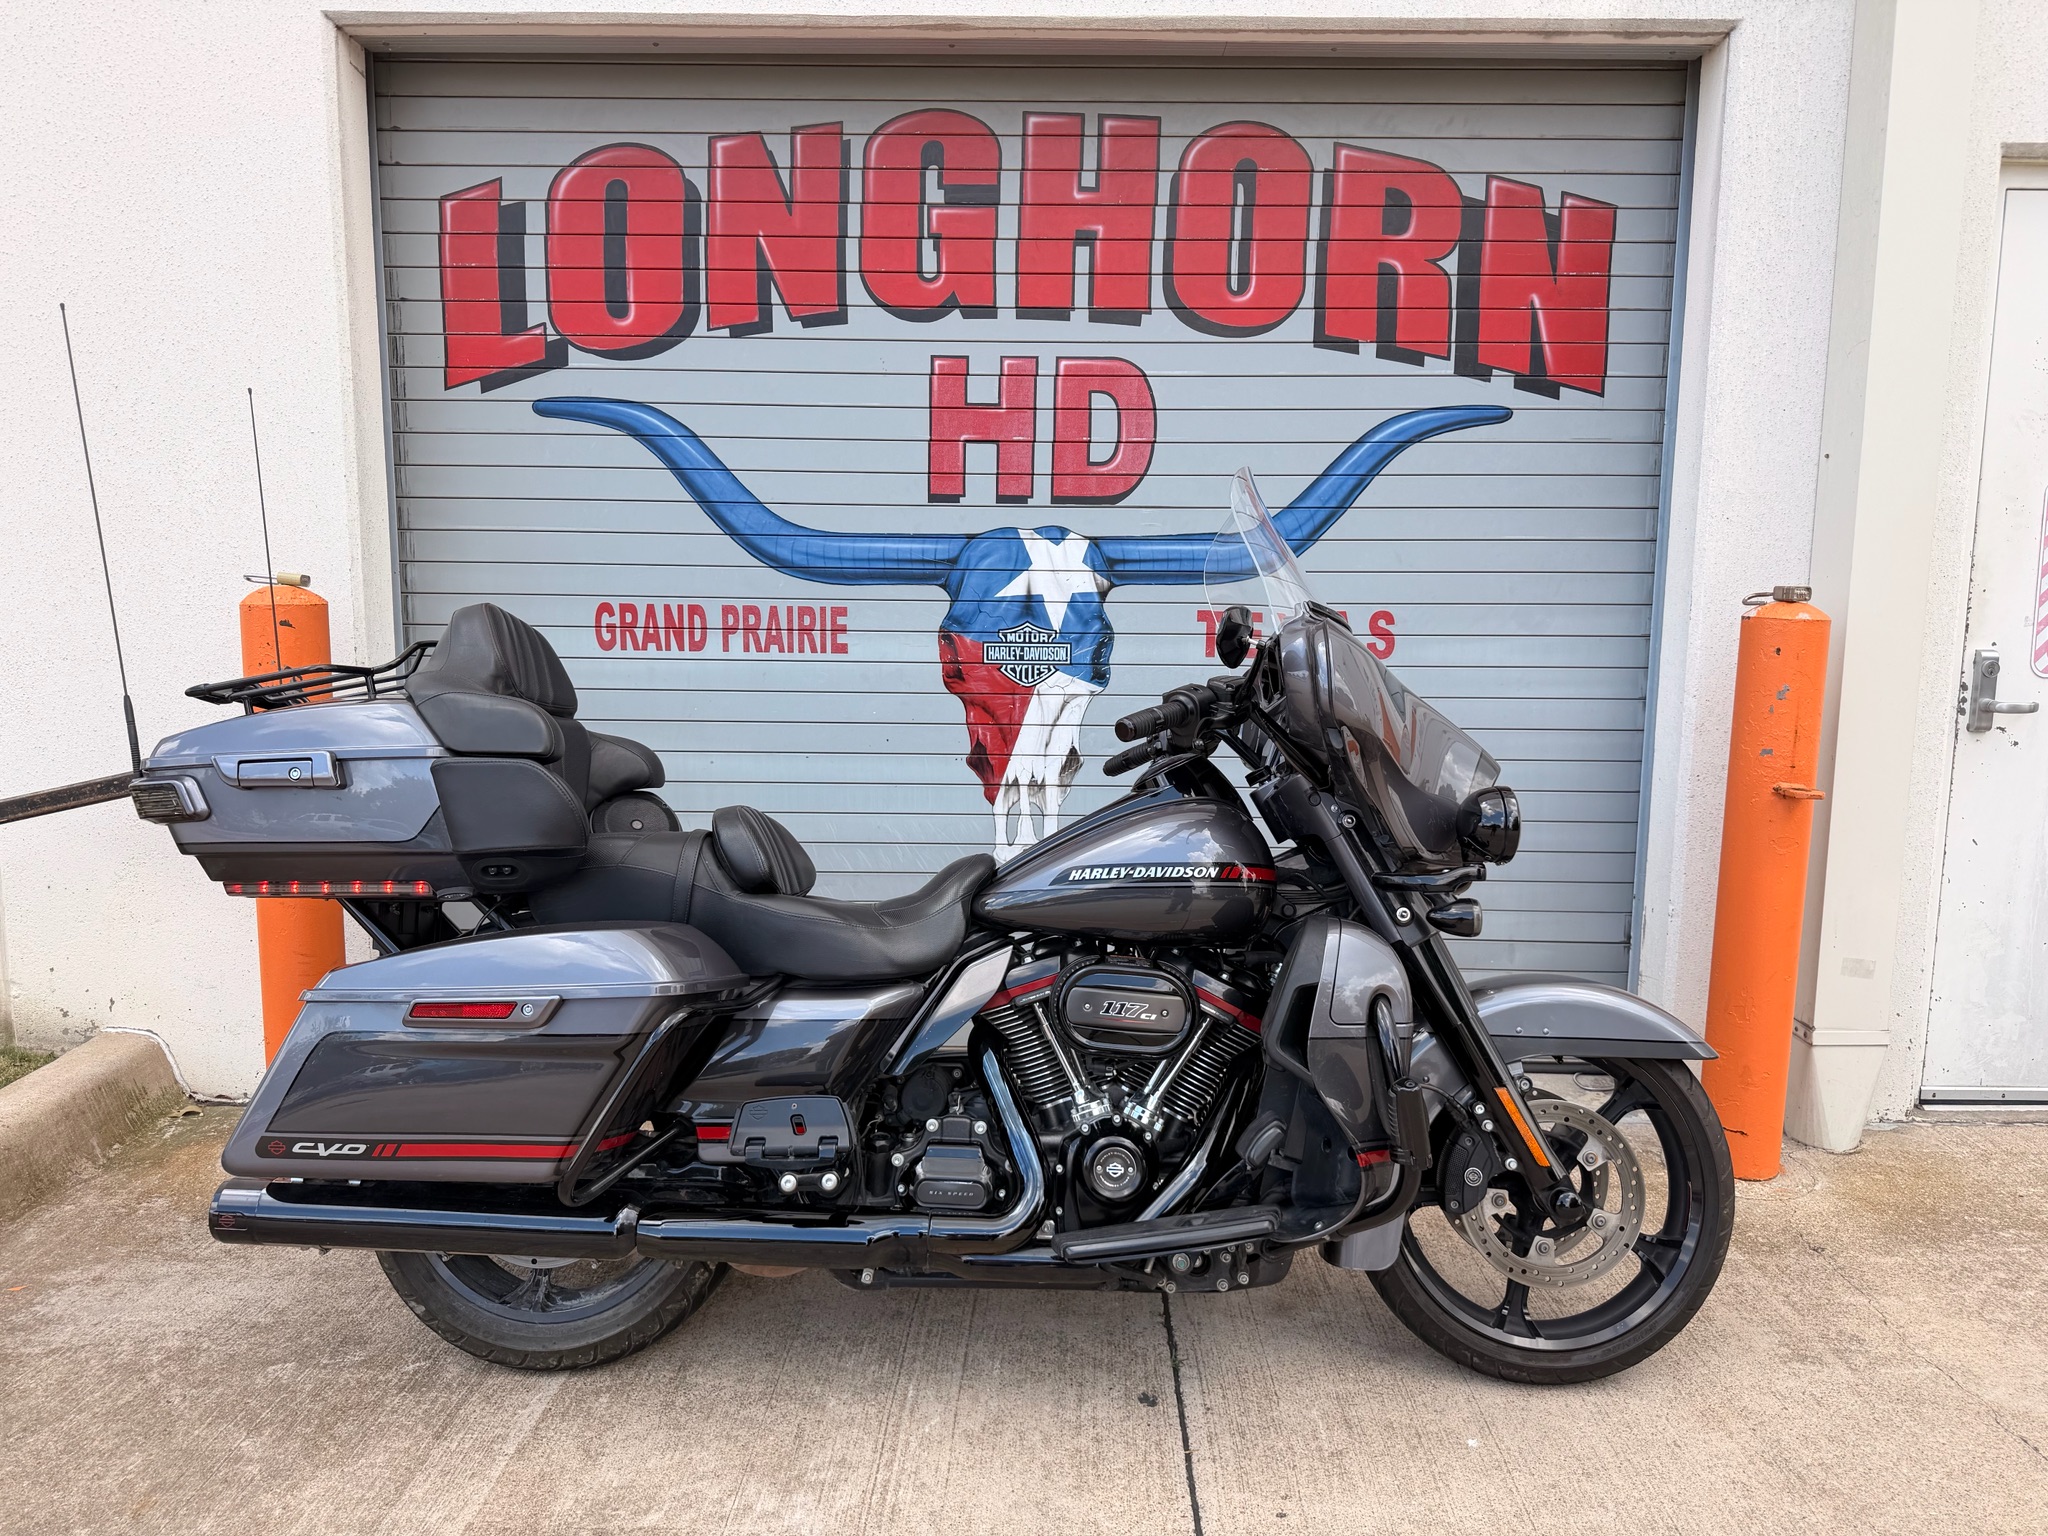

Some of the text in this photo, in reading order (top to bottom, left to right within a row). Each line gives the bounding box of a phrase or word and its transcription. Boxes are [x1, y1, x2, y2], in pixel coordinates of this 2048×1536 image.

[439, 107, 1618, 400] LONGHORN
[928, 355, 1157, 504] HD
[594, 601, 849, 654] GRAND PRAIRIE
[1006, 627, 1049, 642] MOTOR
[1196, 609, 1396, 660] TES
[988, 646, 1067, 661] HARLEY-DAVIDSON
[1007, 664, 1049, 683] CYCLES
[1068, 866, 1219, 881] HARLEY-DAVIDSON
[1100, 1000, 1149, 1018] 117
[291, 1142, 368, 1157] CVO
